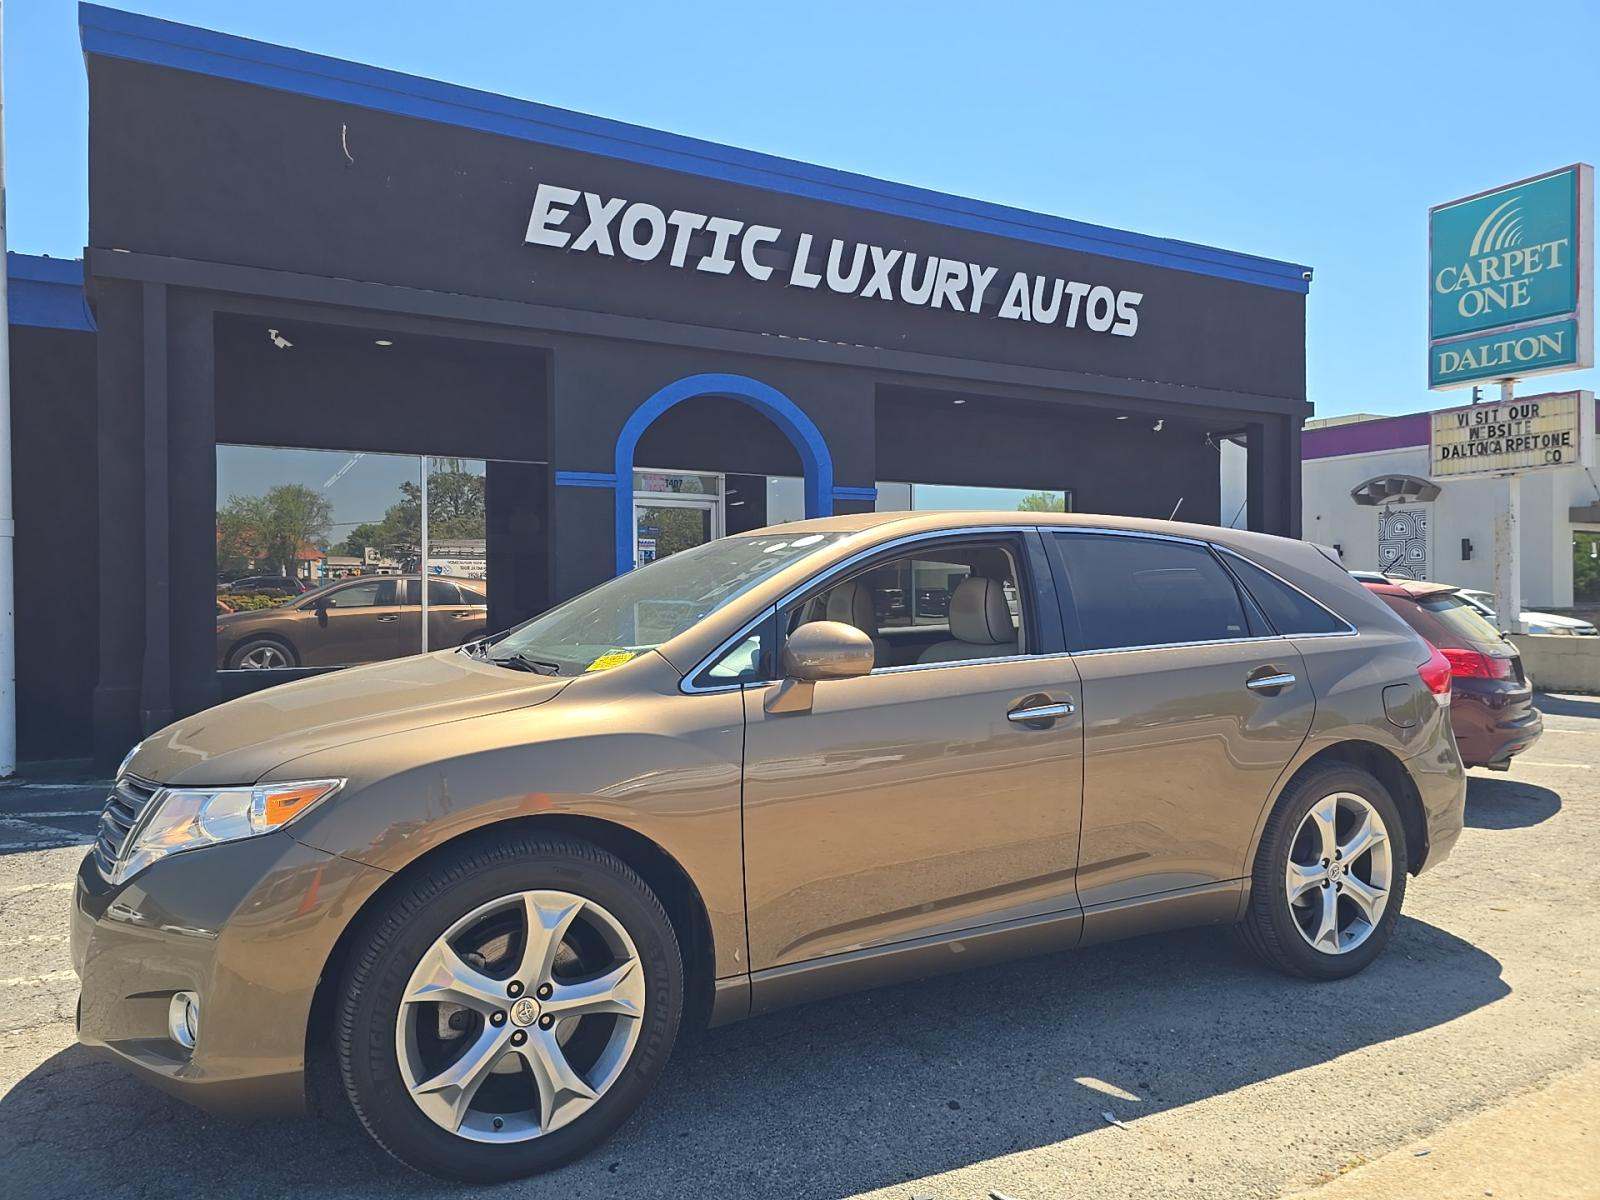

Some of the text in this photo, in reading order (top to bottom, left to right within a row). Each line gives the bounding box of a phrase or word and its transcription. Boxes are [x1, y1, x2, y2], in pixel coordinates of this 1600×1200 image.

[524, 183, 1143, 337] EXOTIC LUXURY AUTOS
[1435, 238, 1568, 294] CARPET
[1458, 279, 1531, 318] ONE
[1439, 332, 1564, 375] DALTON
[1509, 404, 1540, 420] OUR
